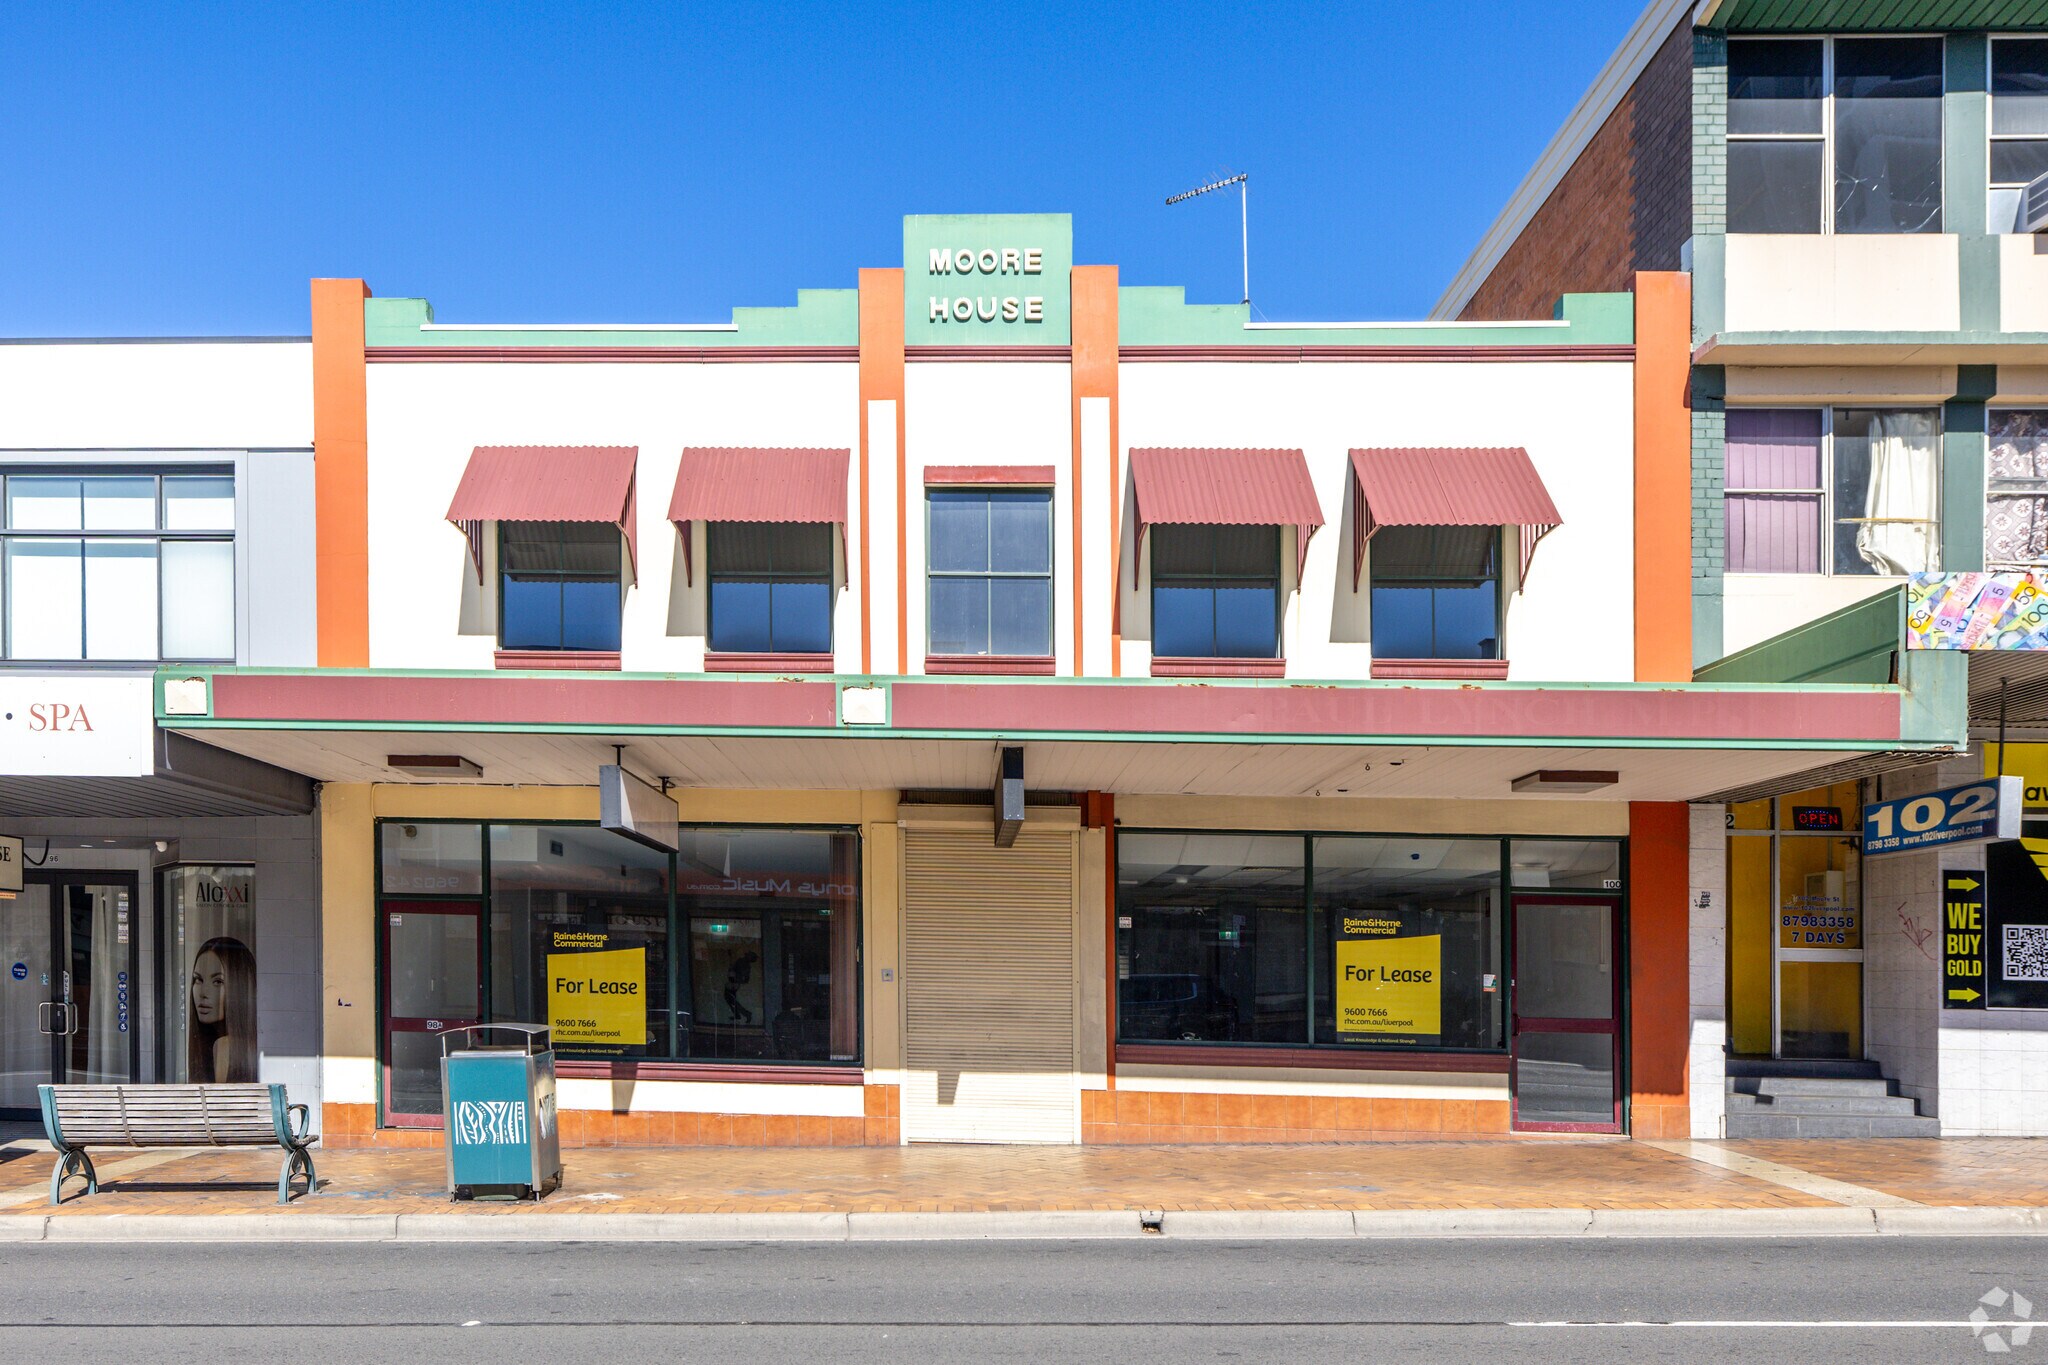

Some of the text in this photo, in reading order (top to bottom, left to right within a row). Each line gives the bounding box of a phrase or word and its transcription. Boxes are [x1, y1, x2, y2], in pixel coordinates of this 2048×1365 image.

[929, 248, 1043, 274] MOORE
[929, 296, 1043, 322] HOUSE
[29, 703, 94, 732] SPA
[1798, 813, 1839, 825] OPEN
[1868, 786, 1997, 838] 102
[1867, 825, 1983, 850] 8798 3358 www.102liverpool.com
[49, 855, 59, 863] 96
[1604, 880, 1622, 889] 100
[196, 882, 248, 903] Aloxxi
[1782, 915, 1854, 928] 87983358
[1947, 902, 1982, 929] WE
[1343, 926, 1397, 935] Commercial
[1791, 931, 1845, 944] 7 DAYS
[553, 940, 603, 948] Commercial
[1947, 934, 1981, 955] BUY
[1345, 965, 1433, 983] For Lease
[1947, 959, 1982, 976] GOLD
[556, 978, 638, 995] For Lease
[1344, 1008, 1388, 1016] 9600 7666
[555, 1019, 576, 1027] 9600
[1344, 1018, 1414, 1027] rhc.com.au/liverpool
[555, 1029, 621, 1038] rhc.com.au/liverpool
